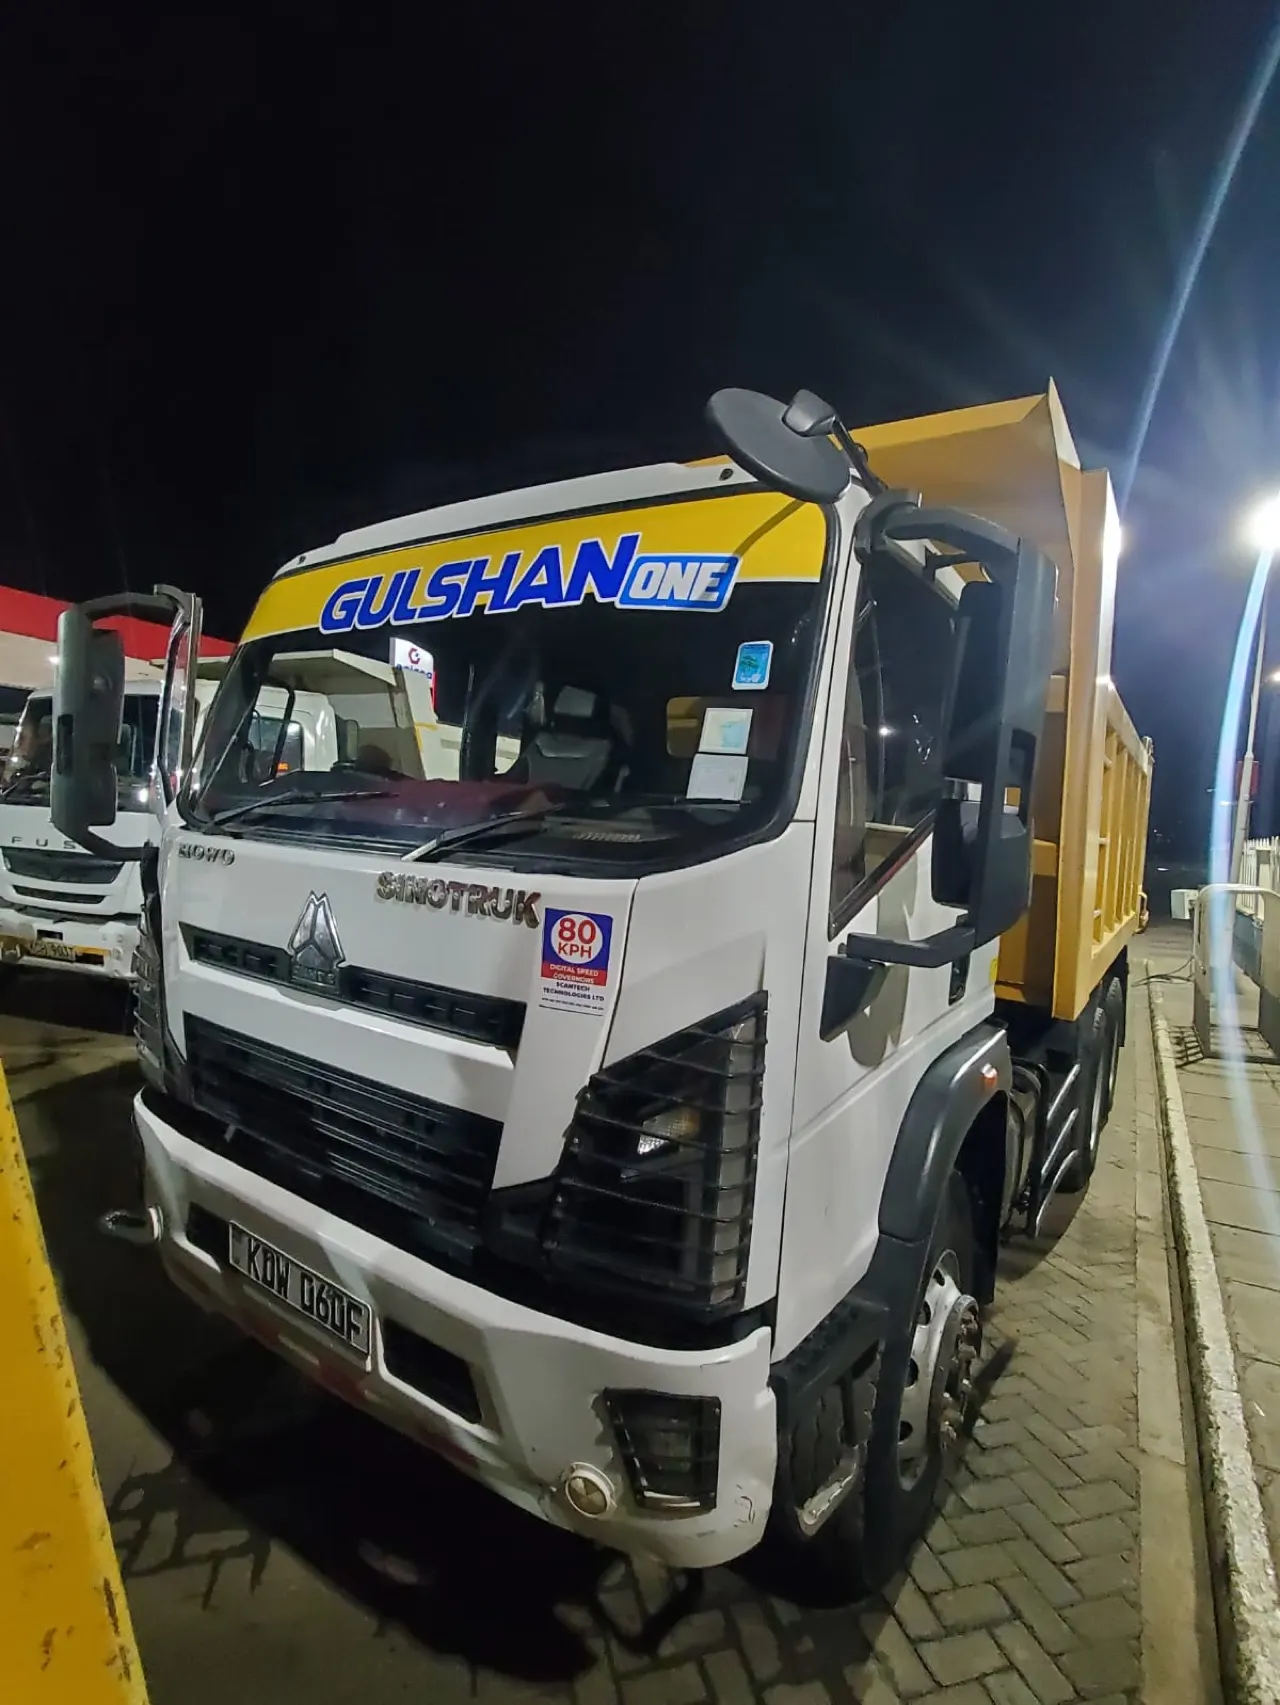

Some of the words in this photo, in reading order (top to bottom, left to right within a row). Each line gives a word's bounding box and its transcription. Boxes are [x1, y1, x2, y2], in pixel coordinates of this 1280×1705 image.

[321, 533, 639, 632] GULSHAN
[628, 562, 730, 602] ONE
[11, 836, 77, 849] FUS
[376, 871, 541, 929] SINOTRUK
[558, 917, 596, 944] 80
[558, 942, 592, 959] KPH
[549, 963, 575, 974] DIGITAL
[576, 966, 599, 977] SPEED
[552, 971, 595, 984] GOVERNORS
[543, 987, 591, 1000] TECHNOLOGIES
[592, 994, 605, 1002] LTD
[247, 1237, 291, 1300] KDW
